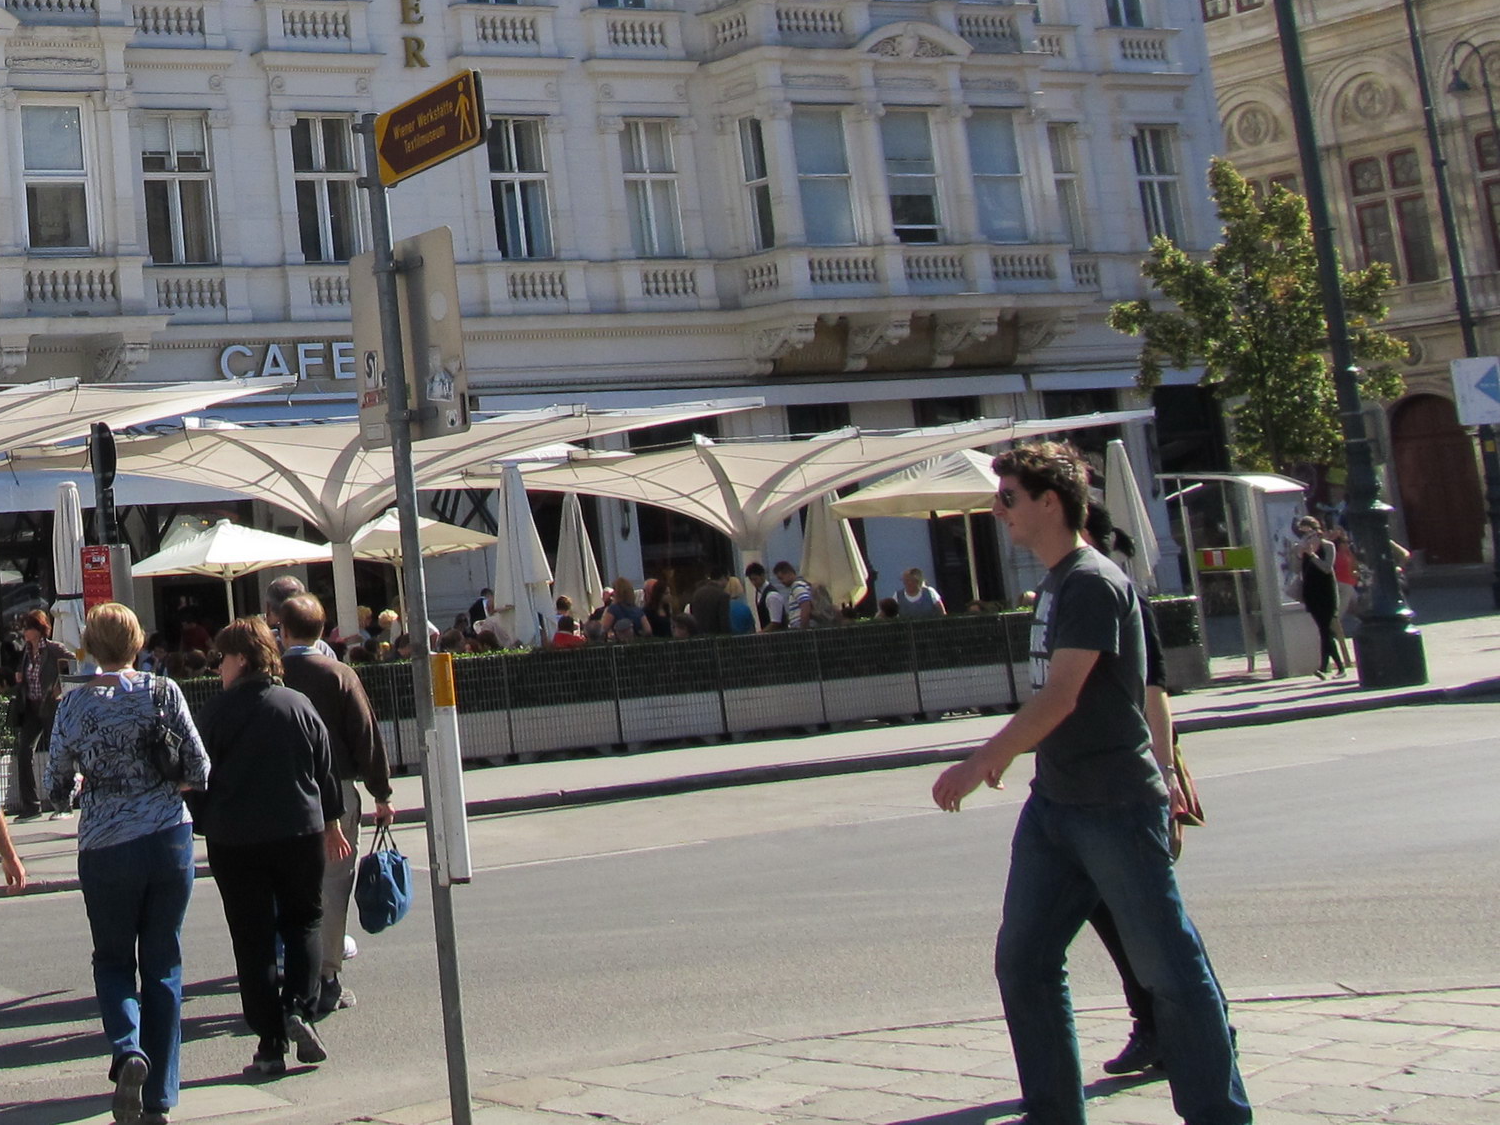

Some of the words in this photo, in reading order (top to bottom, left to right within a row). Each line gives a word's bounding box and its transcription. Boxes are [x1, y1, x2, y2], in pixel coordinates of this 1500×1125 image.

[393, 121, 415, 139] Wiener
[404, 125, 446, 153] Textilmuseum
[220, 342, 355, 379] CAFE
